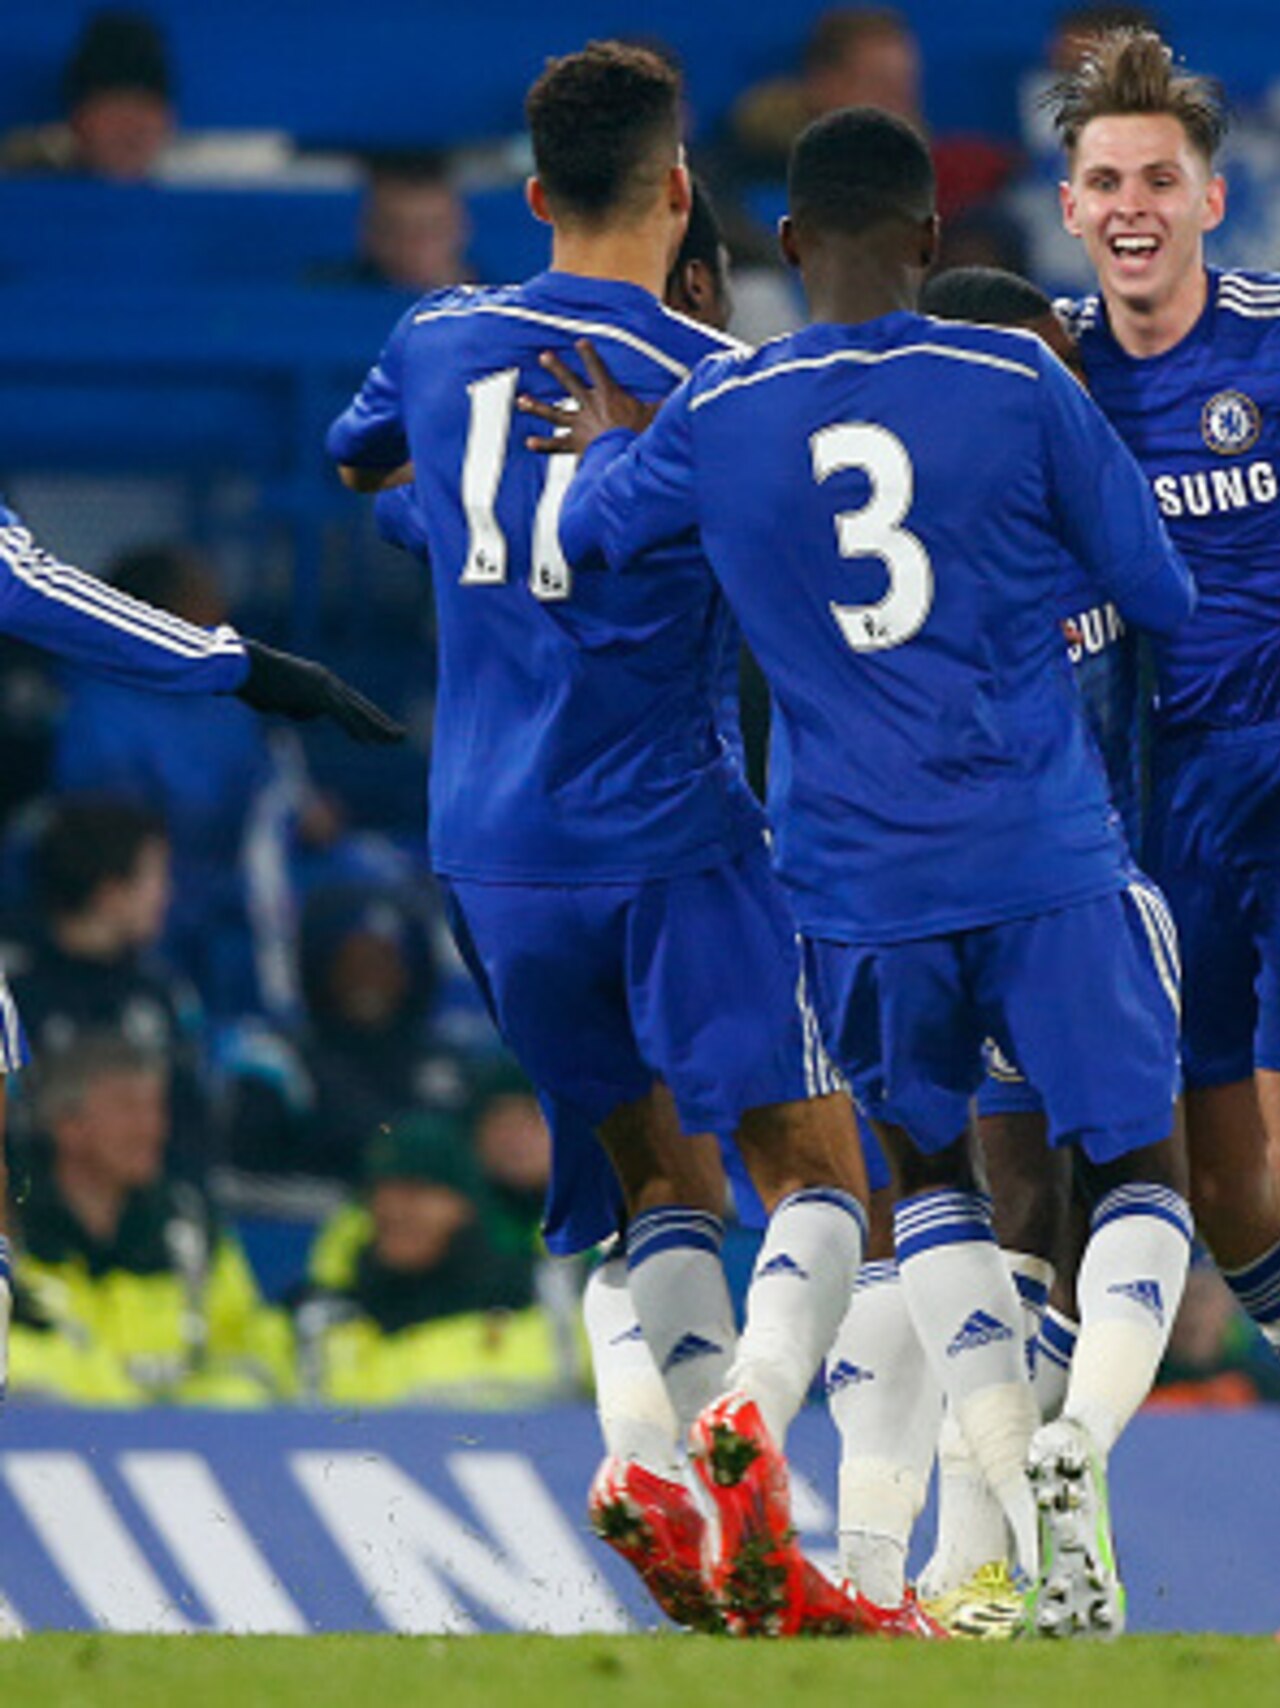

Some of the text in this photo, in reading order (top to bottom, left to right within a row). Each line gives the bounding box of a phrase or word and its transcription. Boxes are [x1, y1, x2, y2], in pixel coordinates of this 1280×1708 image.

[808, 421, 935, 653] 3
[1153, 461, 1278, 517] SUNG
[3, 1450, 842, 1633] UN
